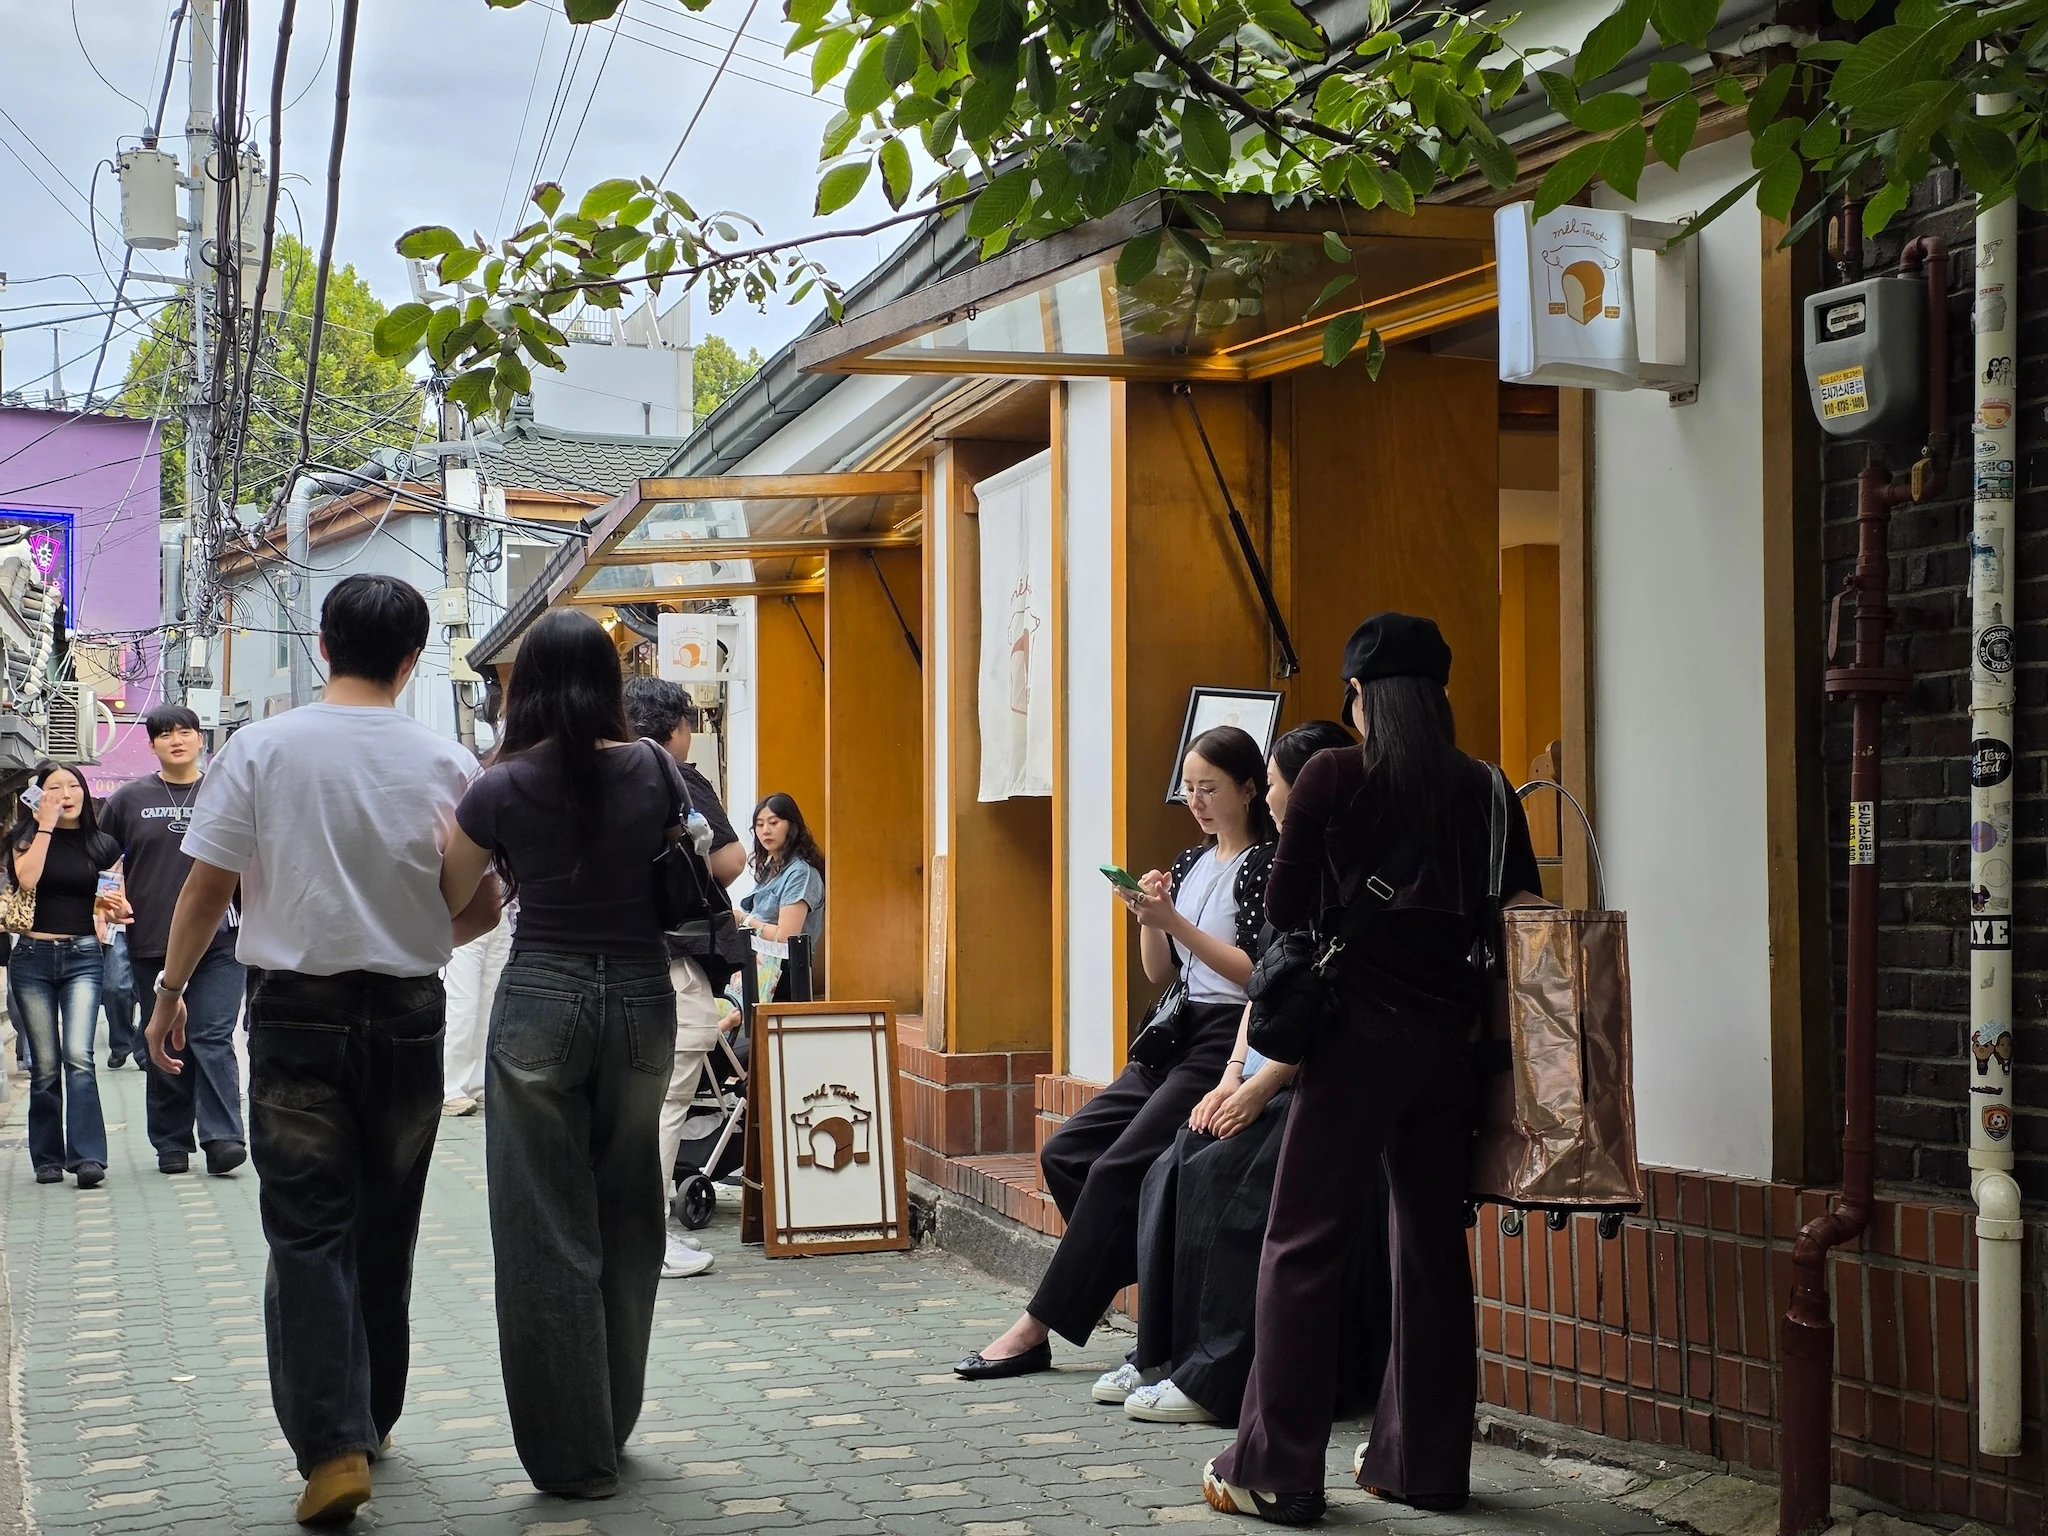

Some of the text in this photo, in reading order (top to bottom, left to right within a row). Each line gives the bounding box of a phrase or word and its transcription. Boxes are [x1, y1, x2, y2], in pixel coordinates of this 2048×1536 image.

[1580, 222, 1608, 243] Toast
[1984, 630, 2010, 642] HOUSE
[141, 807, 180, 819] CALVIN
[1858, 804, 1872, 851] 도시가스시공
